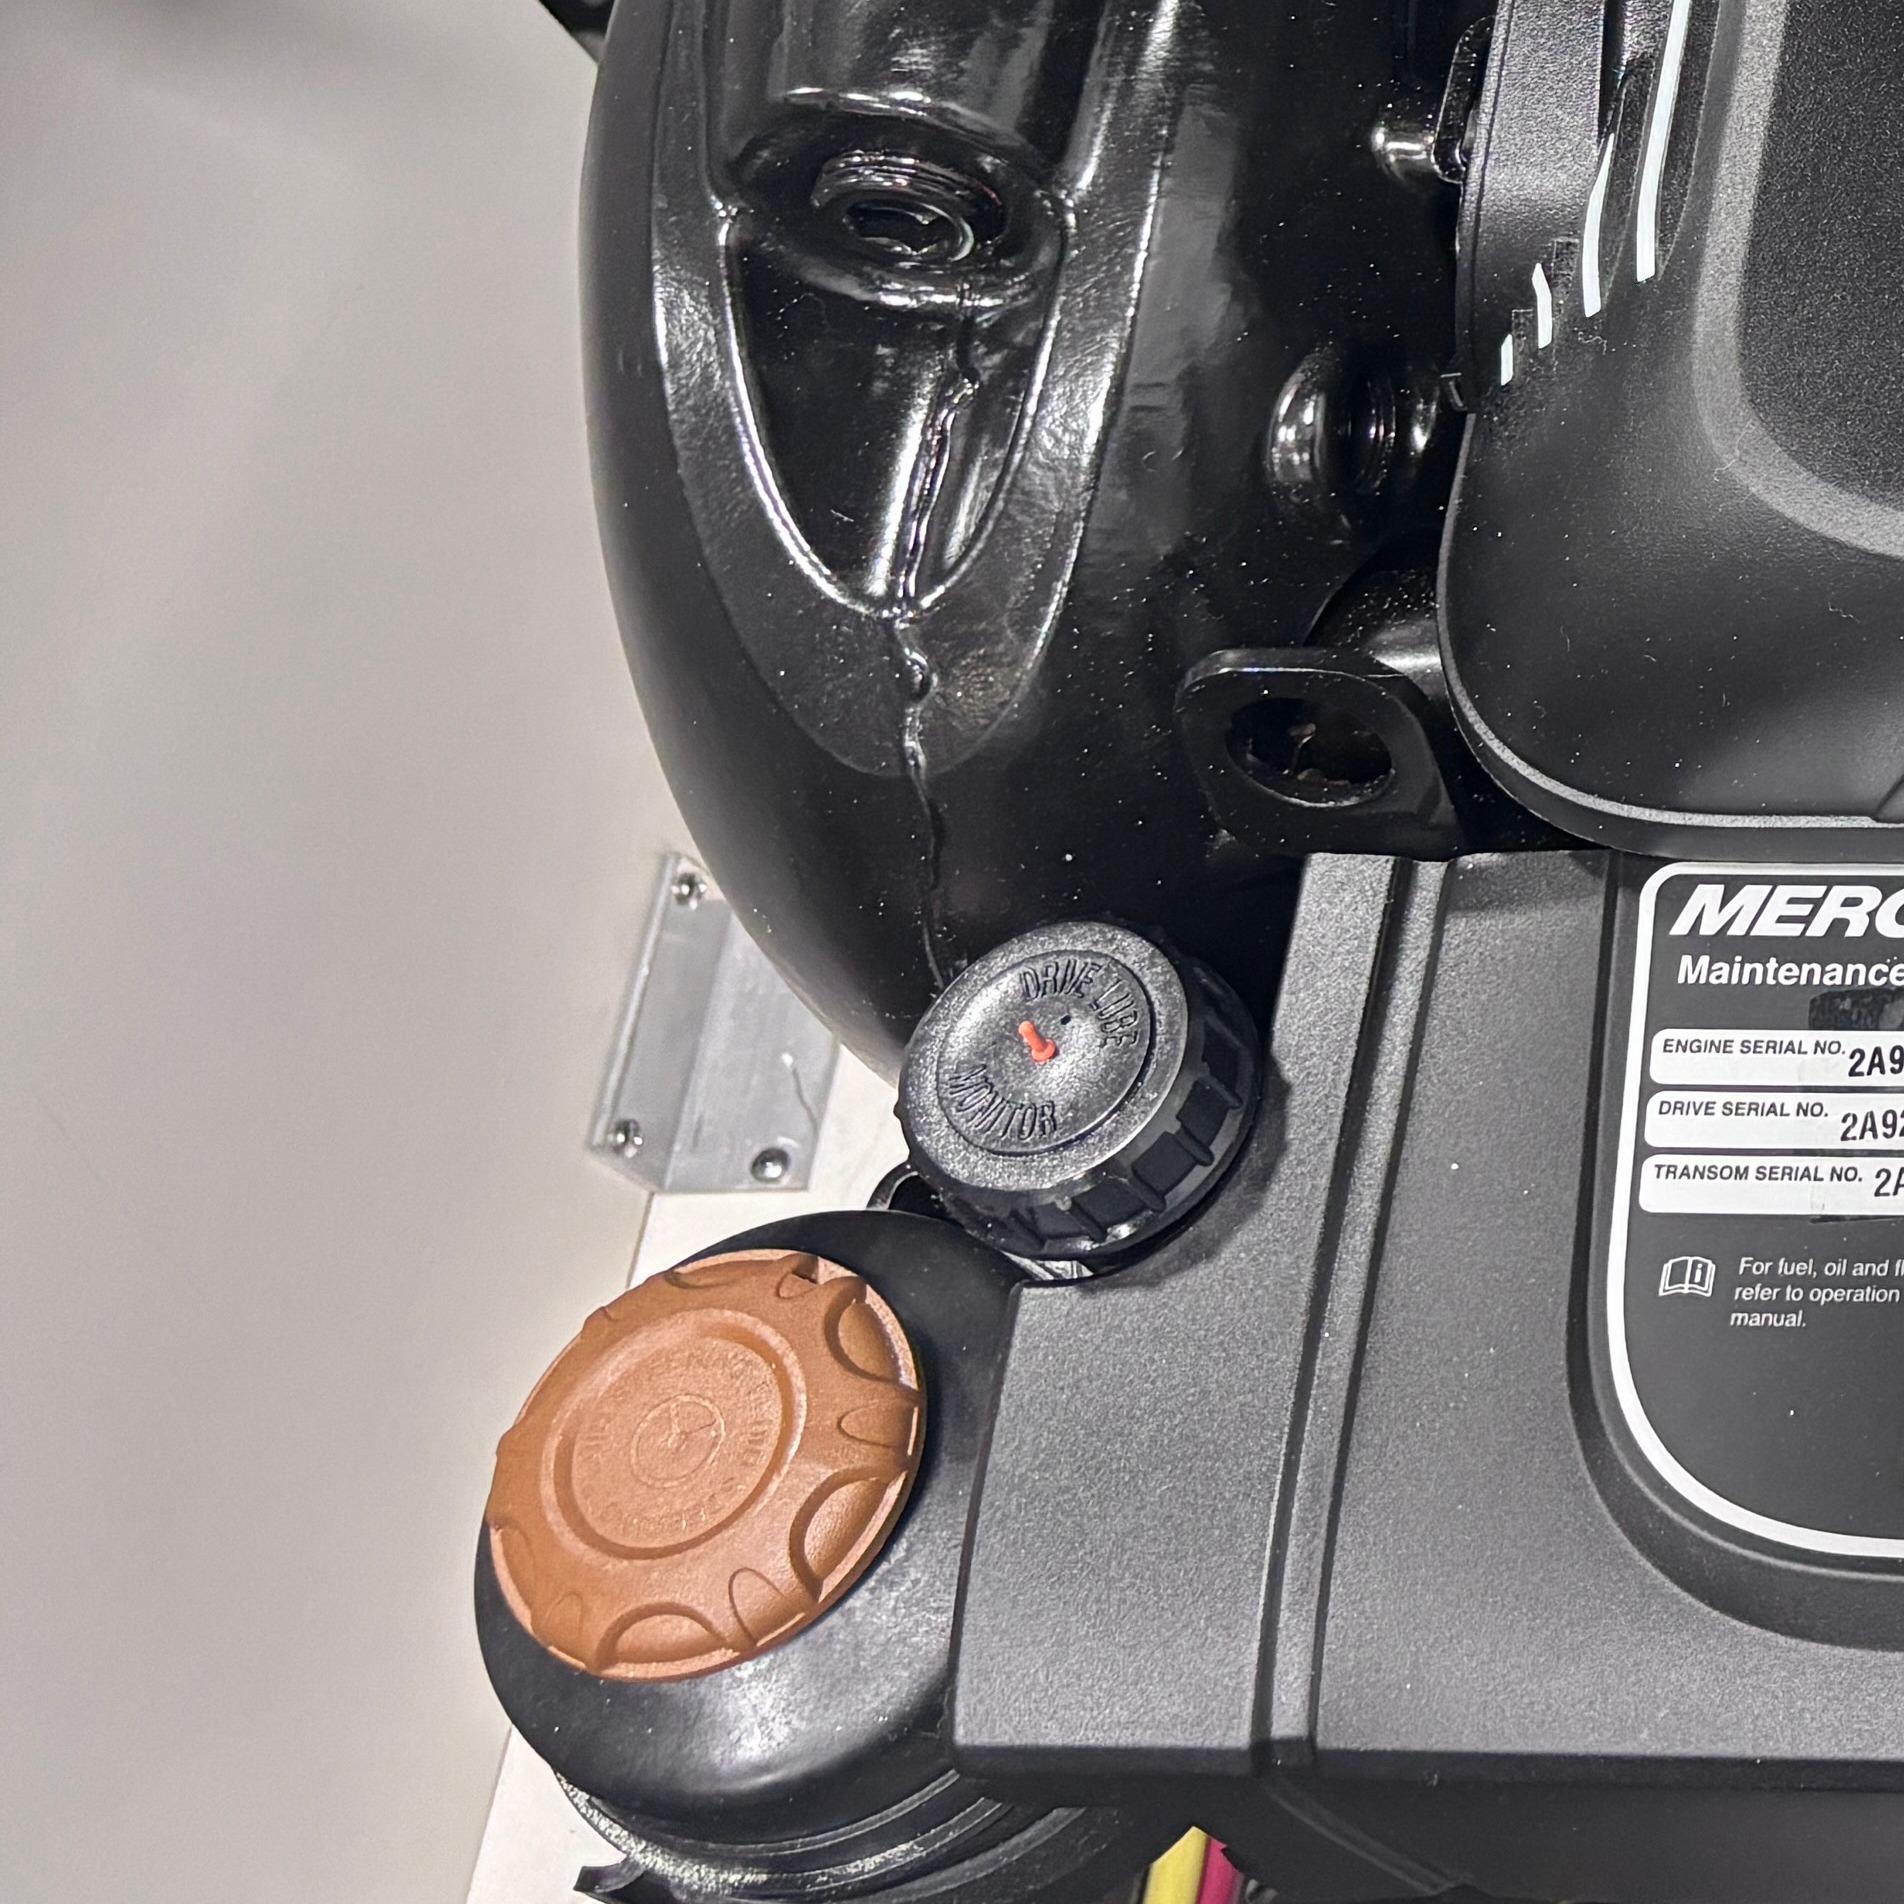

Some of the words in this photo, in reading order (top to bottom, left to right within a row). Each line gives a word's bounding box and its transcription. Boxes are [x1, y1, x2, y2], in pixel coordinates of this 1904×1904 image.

[1019, 958, 1101, 1002] DRIVE
[1088, 979, 1140, 1049] LUBE
[1662, 1038, 1735, 1054] ENGINE
[1739, 1039, 1808, 1055] SERIAL
[1812, 1039, 1846, 1055] NO.
[949, 1063, 1058, 1141] MONITOR
[1658, 1099, 1717, 1116] DRIVE
[1721, 1100, 1790, 1117] SERIAL
[1795, 1101, 1829, 1118] NO.
[1654, 1163, 1749, 1181] TRANSOM
[1754, 1164, 1824, 1182] SERIAL
[1829, 1165, 1863, 1182] NO.
